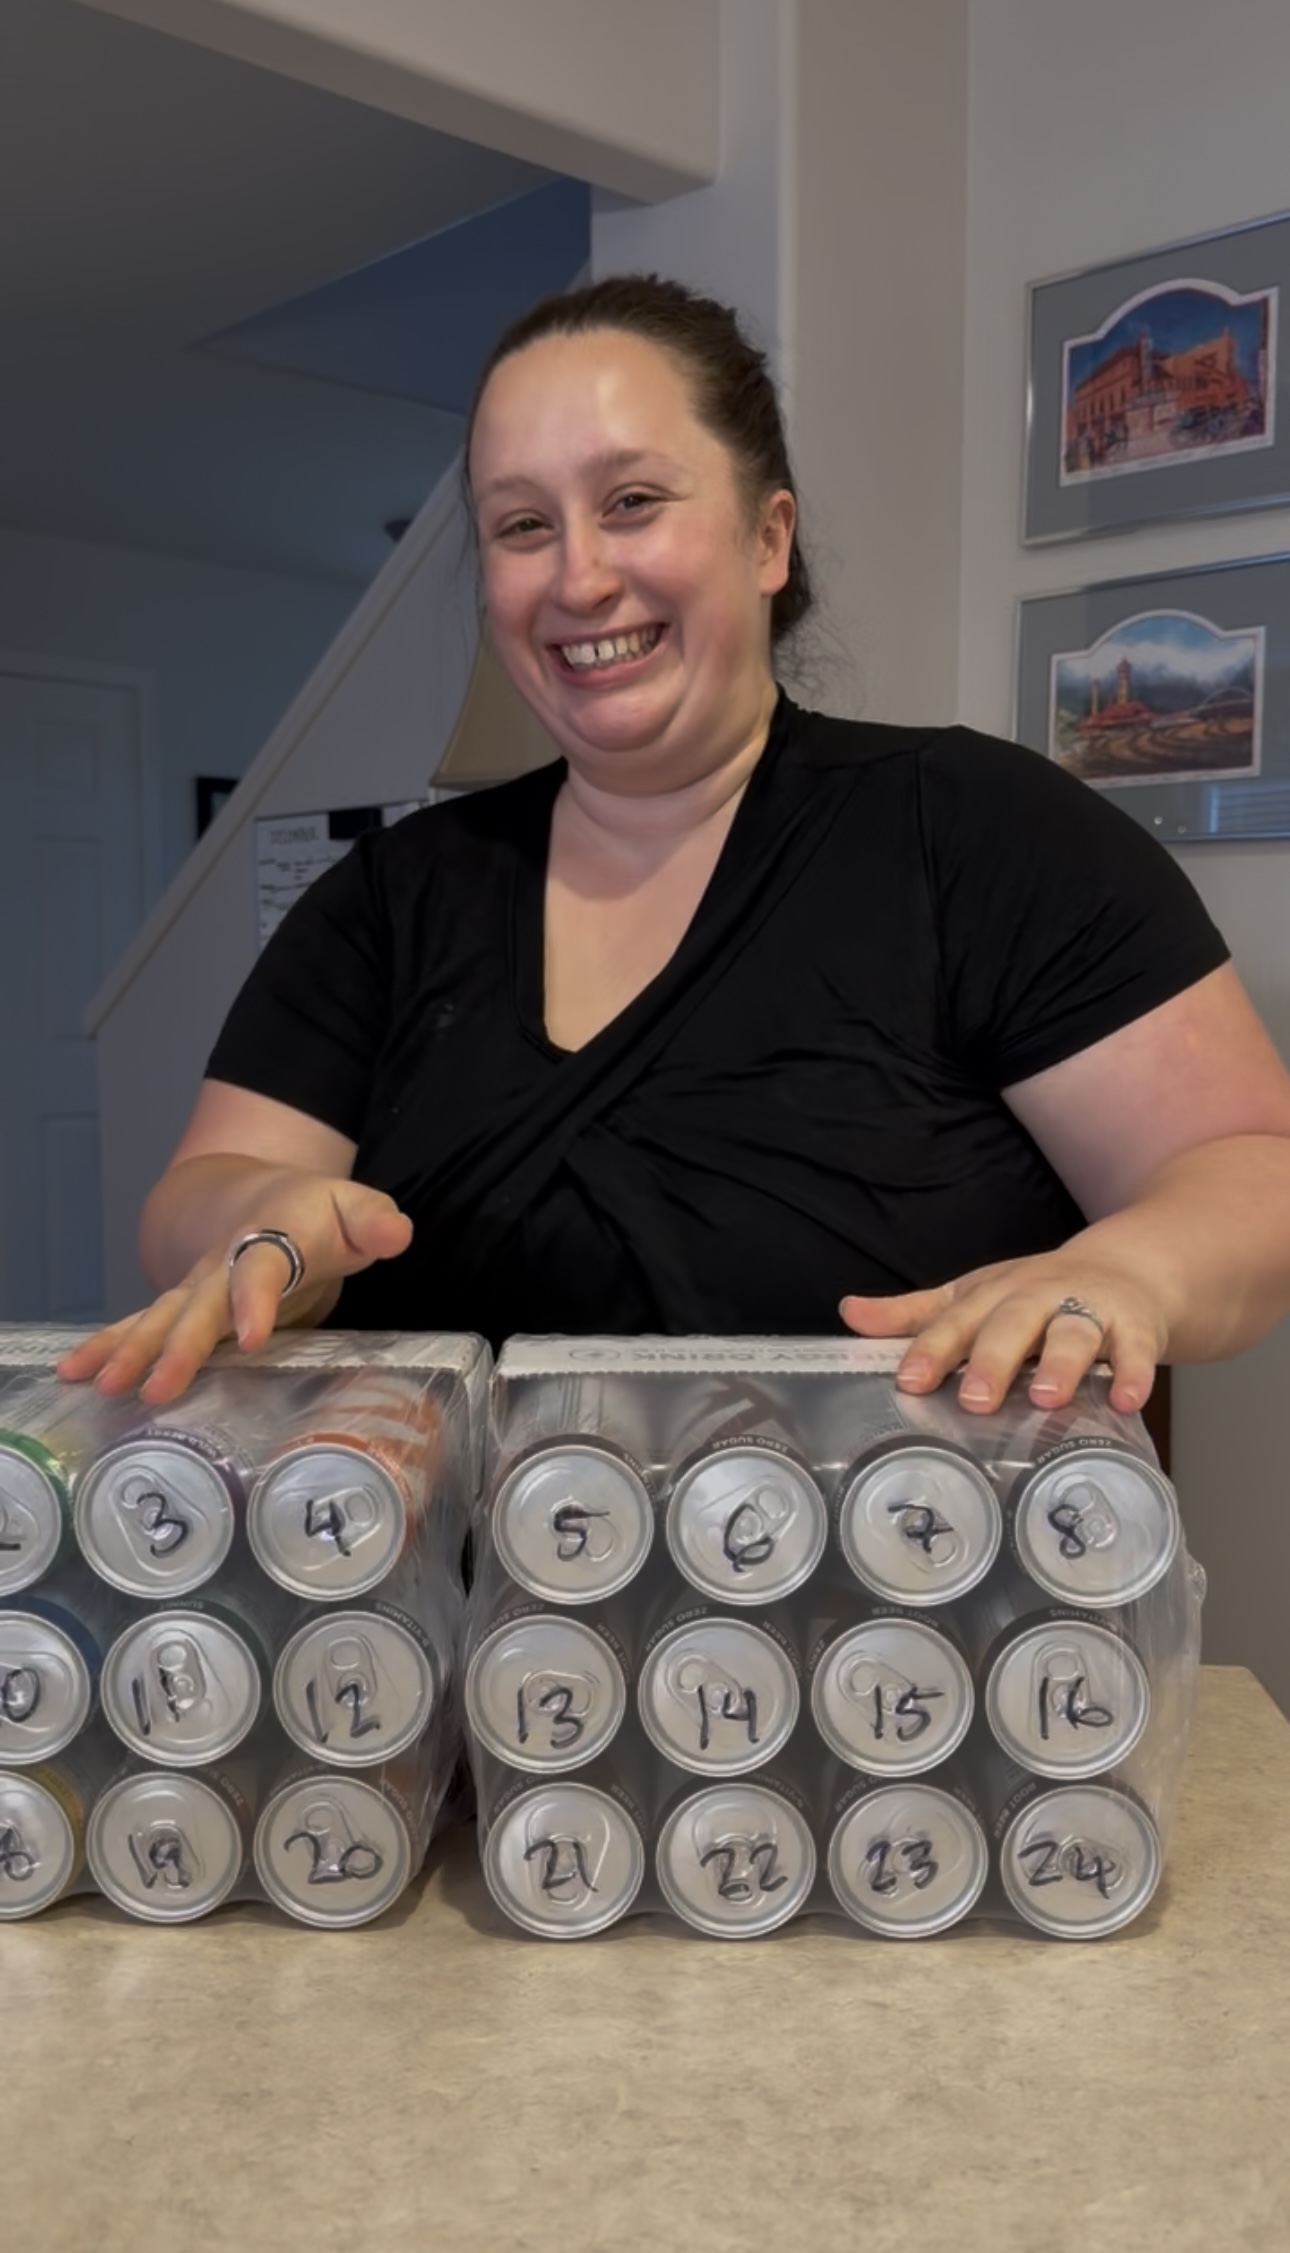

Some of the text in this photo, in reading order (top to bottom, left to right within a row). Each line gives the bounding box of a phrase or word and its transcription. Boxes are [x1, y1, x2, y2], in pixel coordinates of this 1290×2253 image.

[631, 1350, 756, 1362] DRINK
[711, 1435, 788, 1452] ZERO SUGAR
[1034, 1439, 1076, 1465] SUGAR
[137, 1493, 188, 1558] 3
[304, 1498, 353, 1557] 4
[553, 1505, 612, 1562] 5
[723, 1503, 776, 1573] 6
[887, 1502, 955, 1554] 7
[1047, 1503, 1085, 1560] 8
[373, 1601, 431, 1647] B-VITAMINS
[510, 1602, 545, 1615] ZERO
[643, 1606, 707, 1652] ZERO SUGAR
[906, 1609, 940, 1627] ROOT
[1, 1667, 40, 1723] 0
[305, 1680, 380, 1743] 12
[517, 1686, 584, 1748] 13
[696, 1684, 760, 1750] 14
[873, 1683, 945, 1741] 15
[1038, 1676, 1114, 1740] 16
[832, 1779, 867, 1813] SUGAR
[1006, 1780, 1037, 1809] ROOT
[128, 1834, 190, 1888] 19
[283, 1831, 383, 1884] 20
[523, 1840, 598, 1892] 21
[701, 1843, 788, 1899] 22
[865, 1840, 938, 1892] 23
[1018, 1840, 1116, 1899] 24
